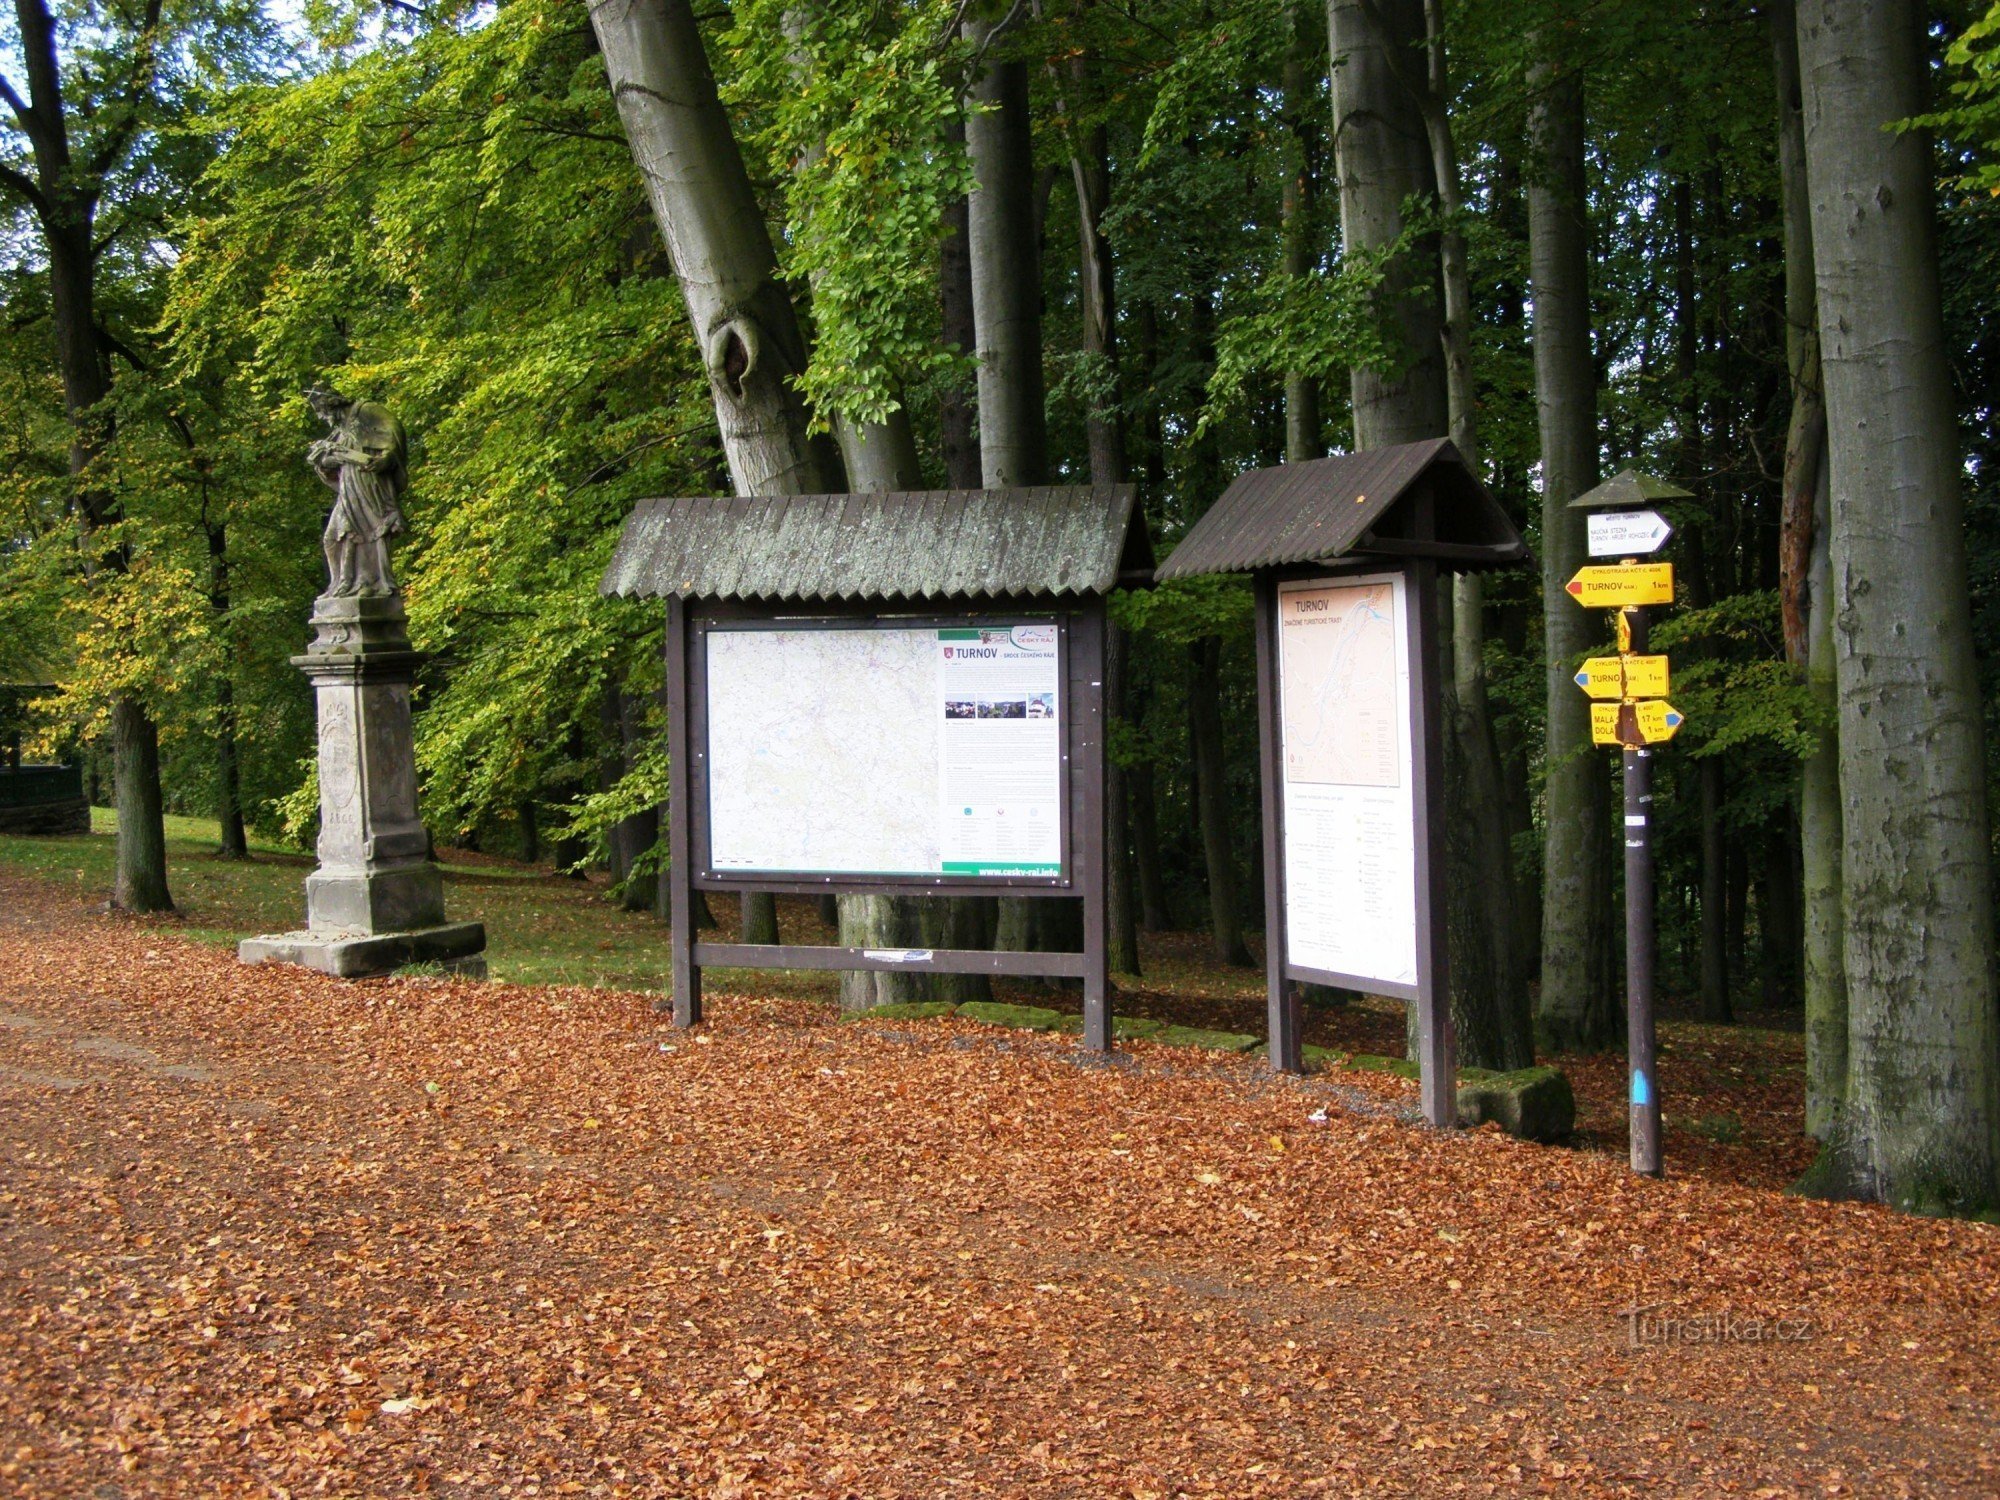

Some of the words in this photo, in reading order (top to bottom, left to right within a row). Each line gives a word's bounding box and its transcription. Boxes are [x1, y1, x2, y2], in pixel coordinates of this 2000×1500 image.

[1587, 582, 1623, 591] TURNOV
[1652, 581, 1657, 589] 1
[1296, 599, 1329, 613] TURNOV
[956, 648, 997, 659] TURNOV
[1592, 674, 1621, 683] TURNO
[1648, 673, 1652, 681] 1
[1642, 714, 1651, 722] 17
[1648, 726, 1652, 734] 1
